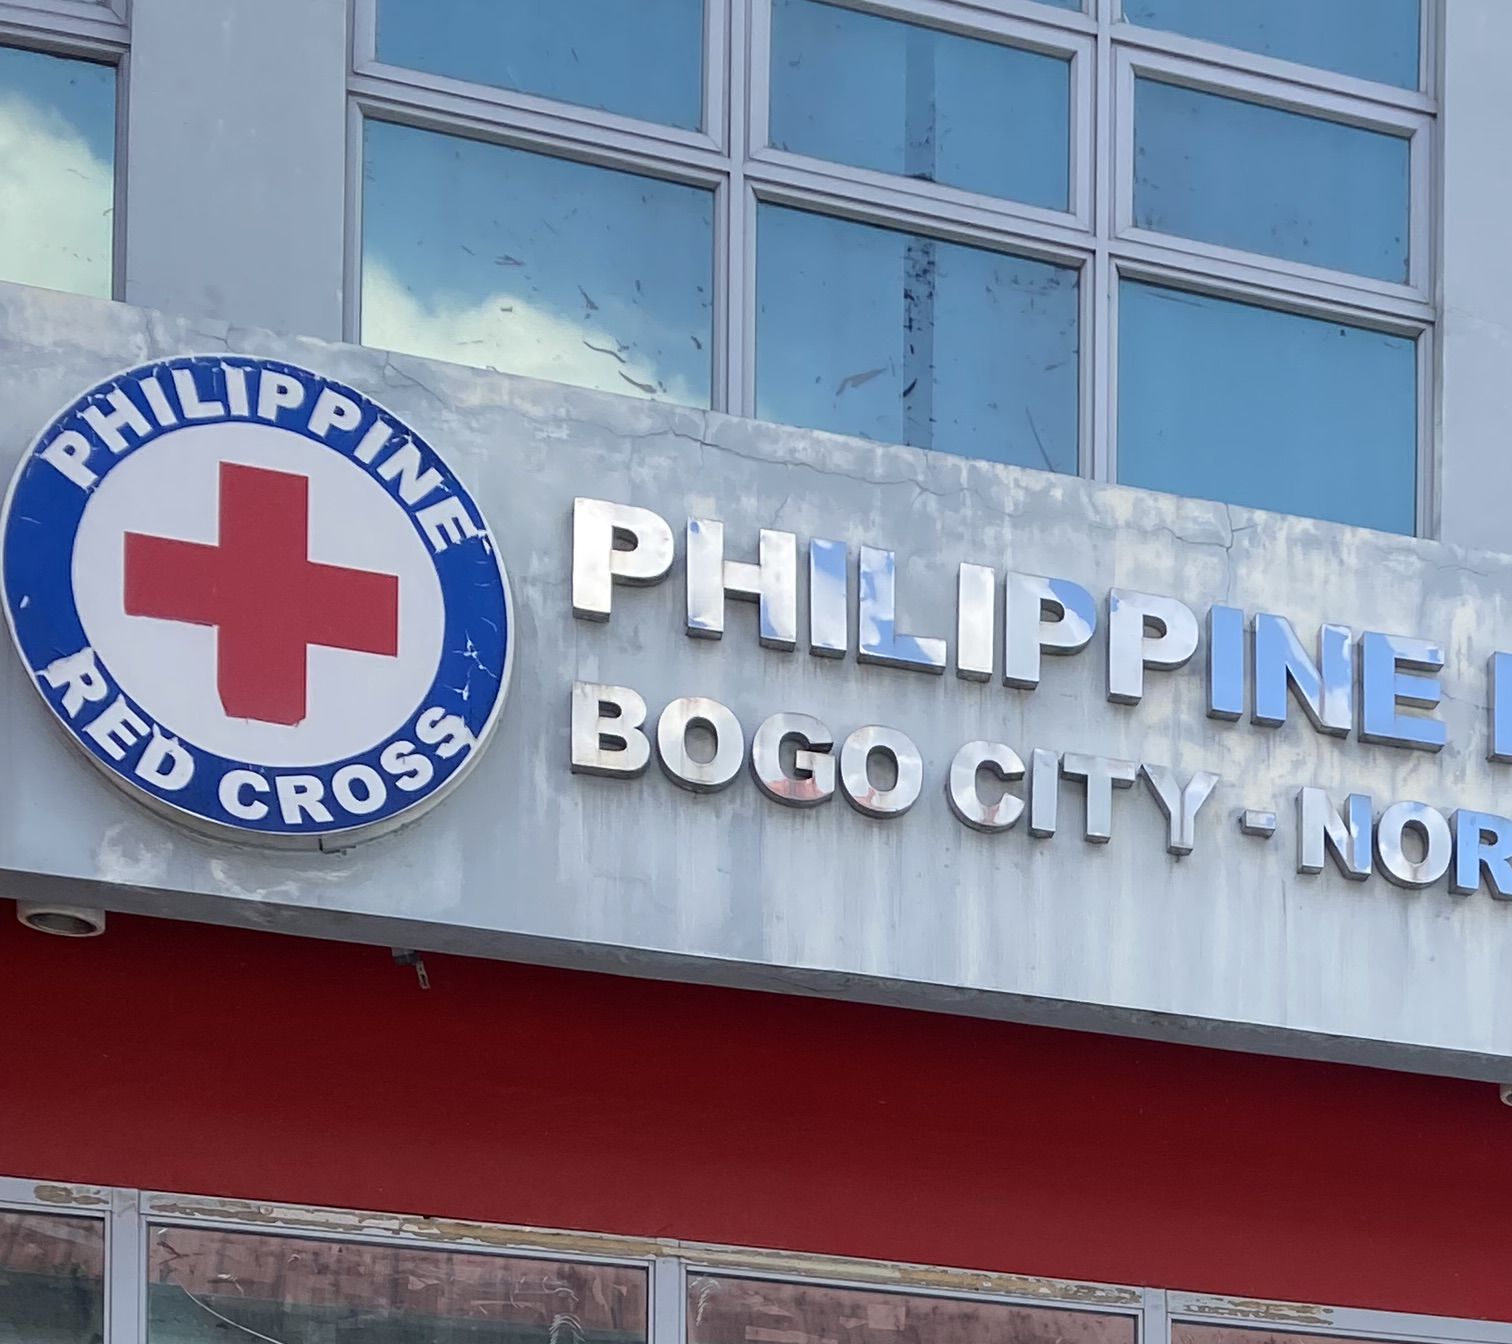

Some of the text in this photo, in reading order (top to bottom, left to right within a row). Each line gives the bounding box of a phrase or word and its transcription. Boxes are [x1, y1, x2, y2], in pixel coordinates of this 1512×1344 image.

[41, 366, 483, 553] PHILIPPINE
[571, 496, 1446, 754] PHILIPPINE
[38, 647, 477, 824] RED CROSS
[571, 679, 923, 820] BOGO
[946, 740, 1220, 856] CITY
